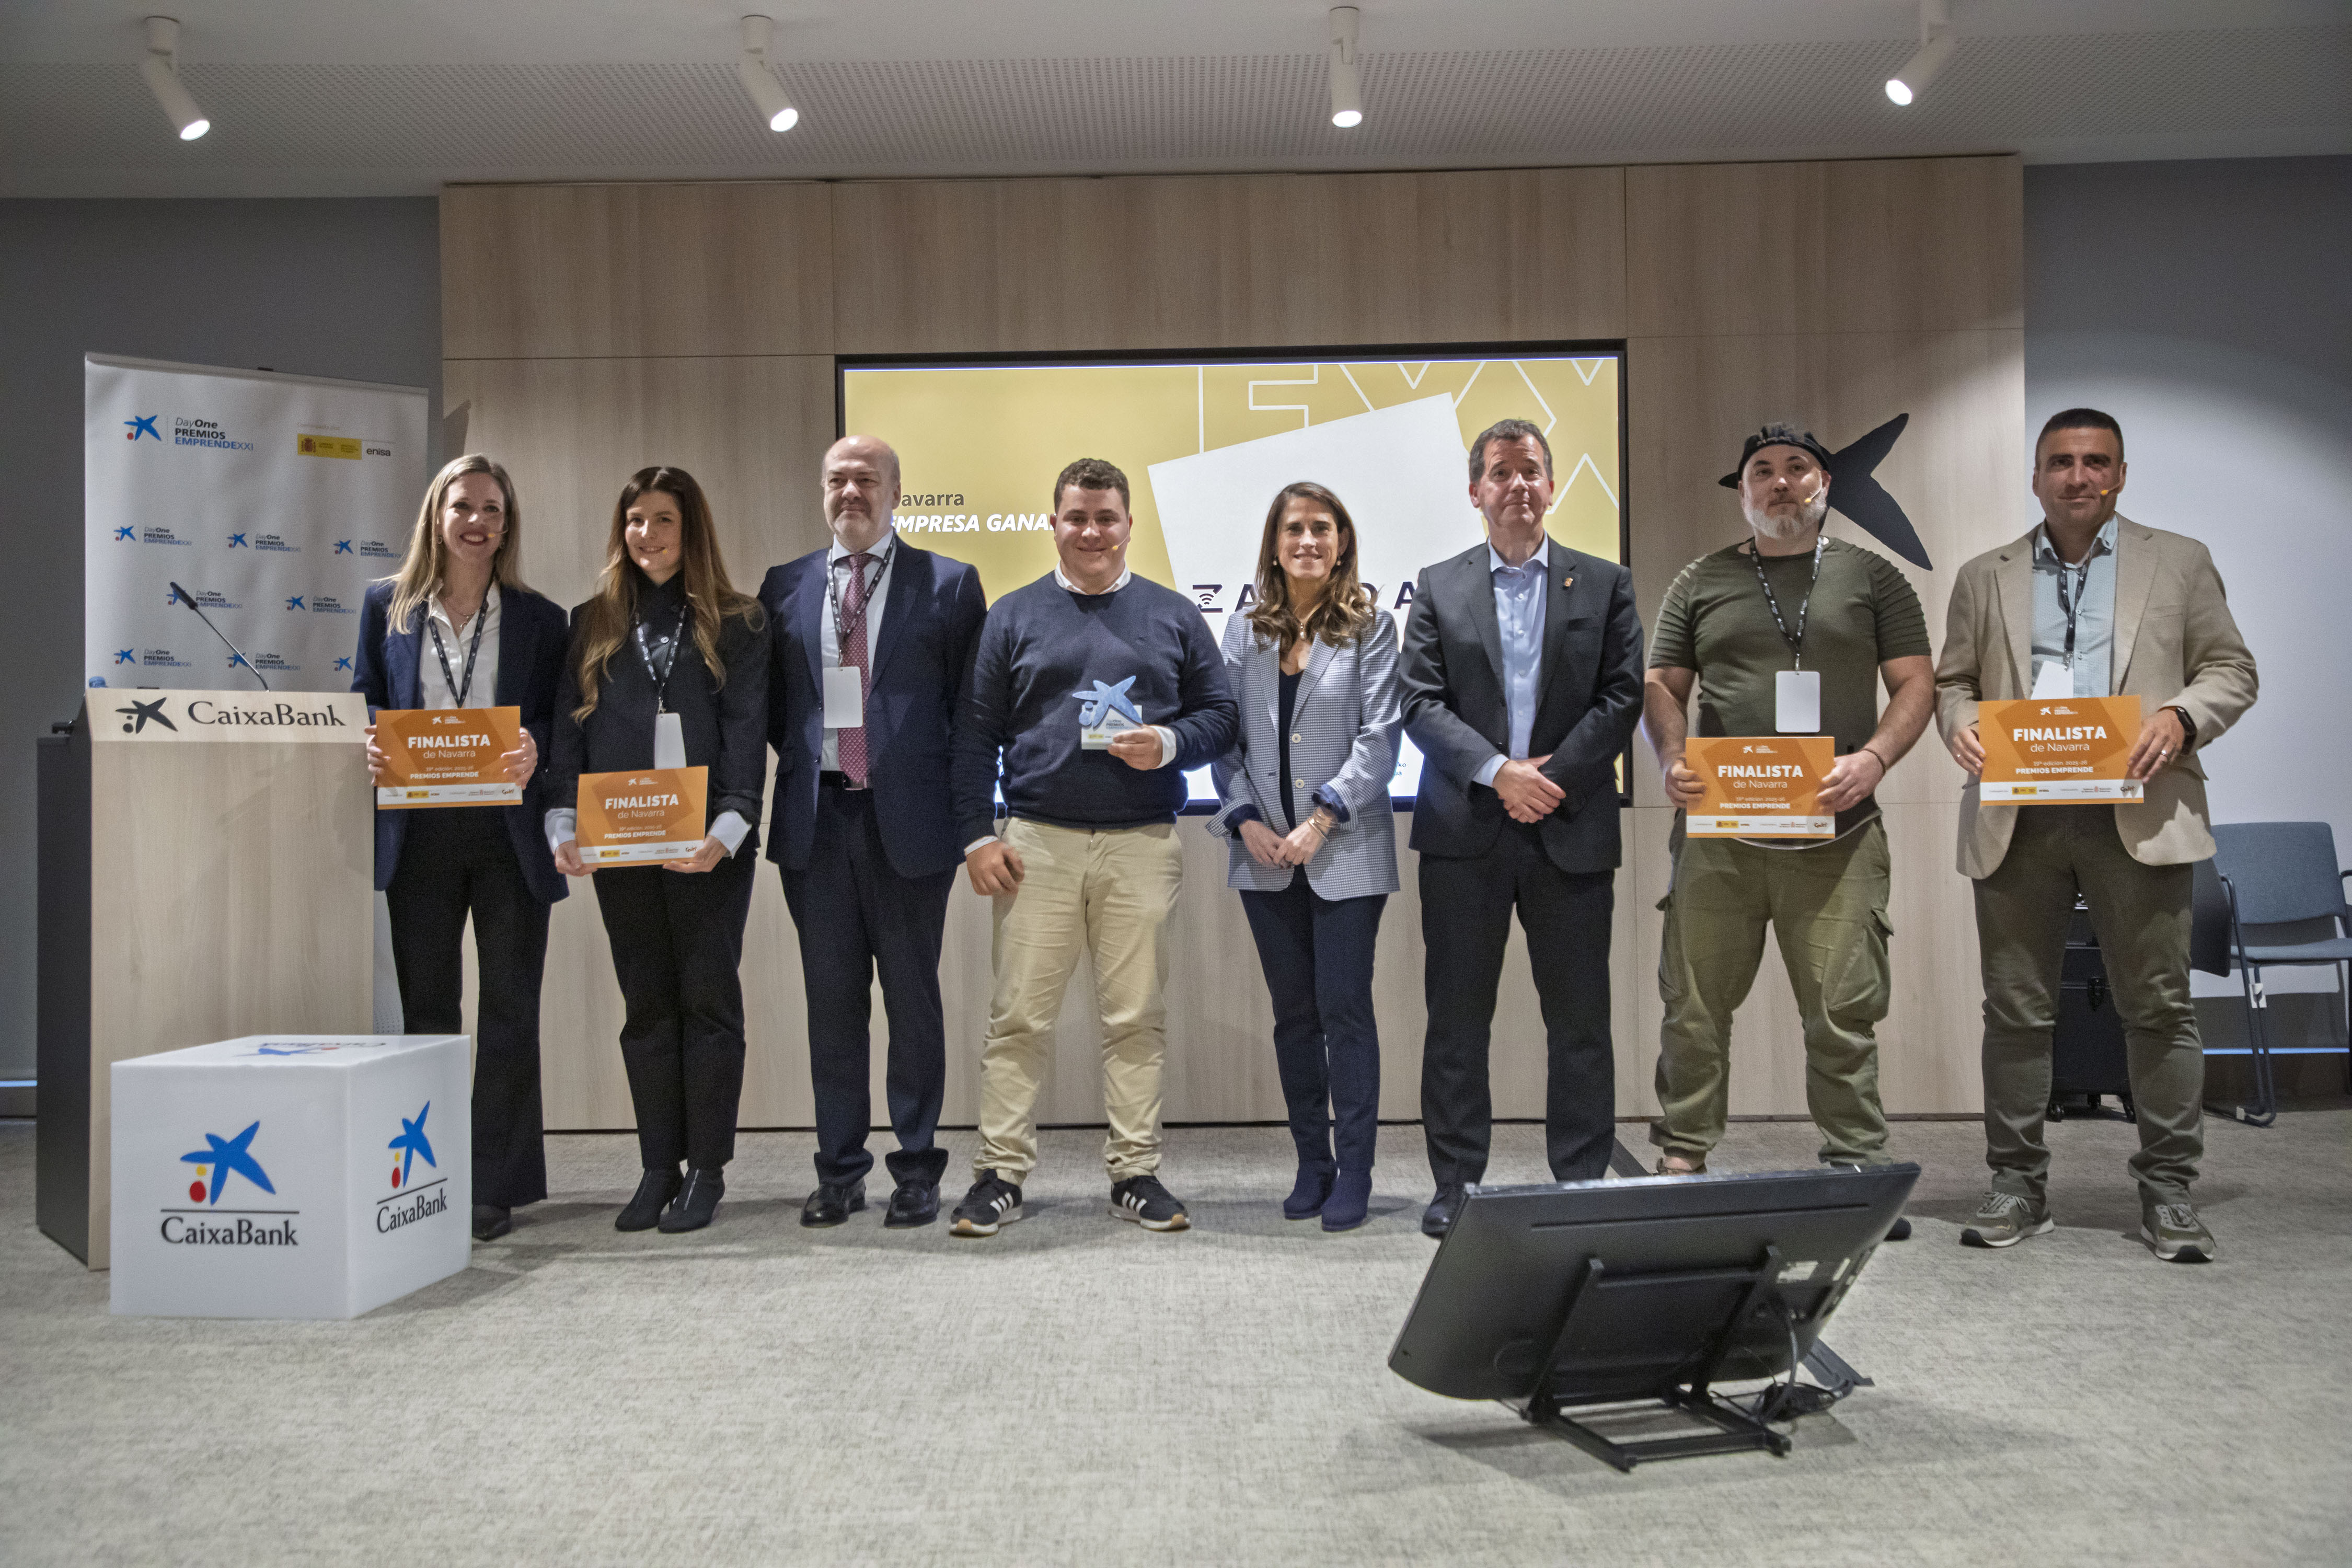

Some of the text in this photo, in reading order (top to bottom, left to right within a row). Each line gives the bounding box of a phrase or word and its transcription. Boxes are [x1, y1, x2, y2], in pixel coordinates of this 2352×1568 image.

[176, 418, 217, 429] DayOne
[175, 428, 226, 439] PREMIOS
[175, 437, 253, 451] EMPRENDEXXI
[366, 448, 391, 456] enisa
[901, 493, 964, 506] avarra
[986, 514, 1054, 532] GANA
[188, 701, 347, 726] CaixaBank
[2013, 726, 2107, 741] FINALISTA
[408, 734, 490, 748] FINALISTA
[2031, 743, 2090, 752] de Navarra
[423, 750, 435, 758] de
[1718, 765, 1803, 777] FINALISTA
[605, 794, 679, 810] FINALISTA
[377, 1189, 447, 1234] CaixaBank
[160, 1216, 298, 1246] CaixaBank
